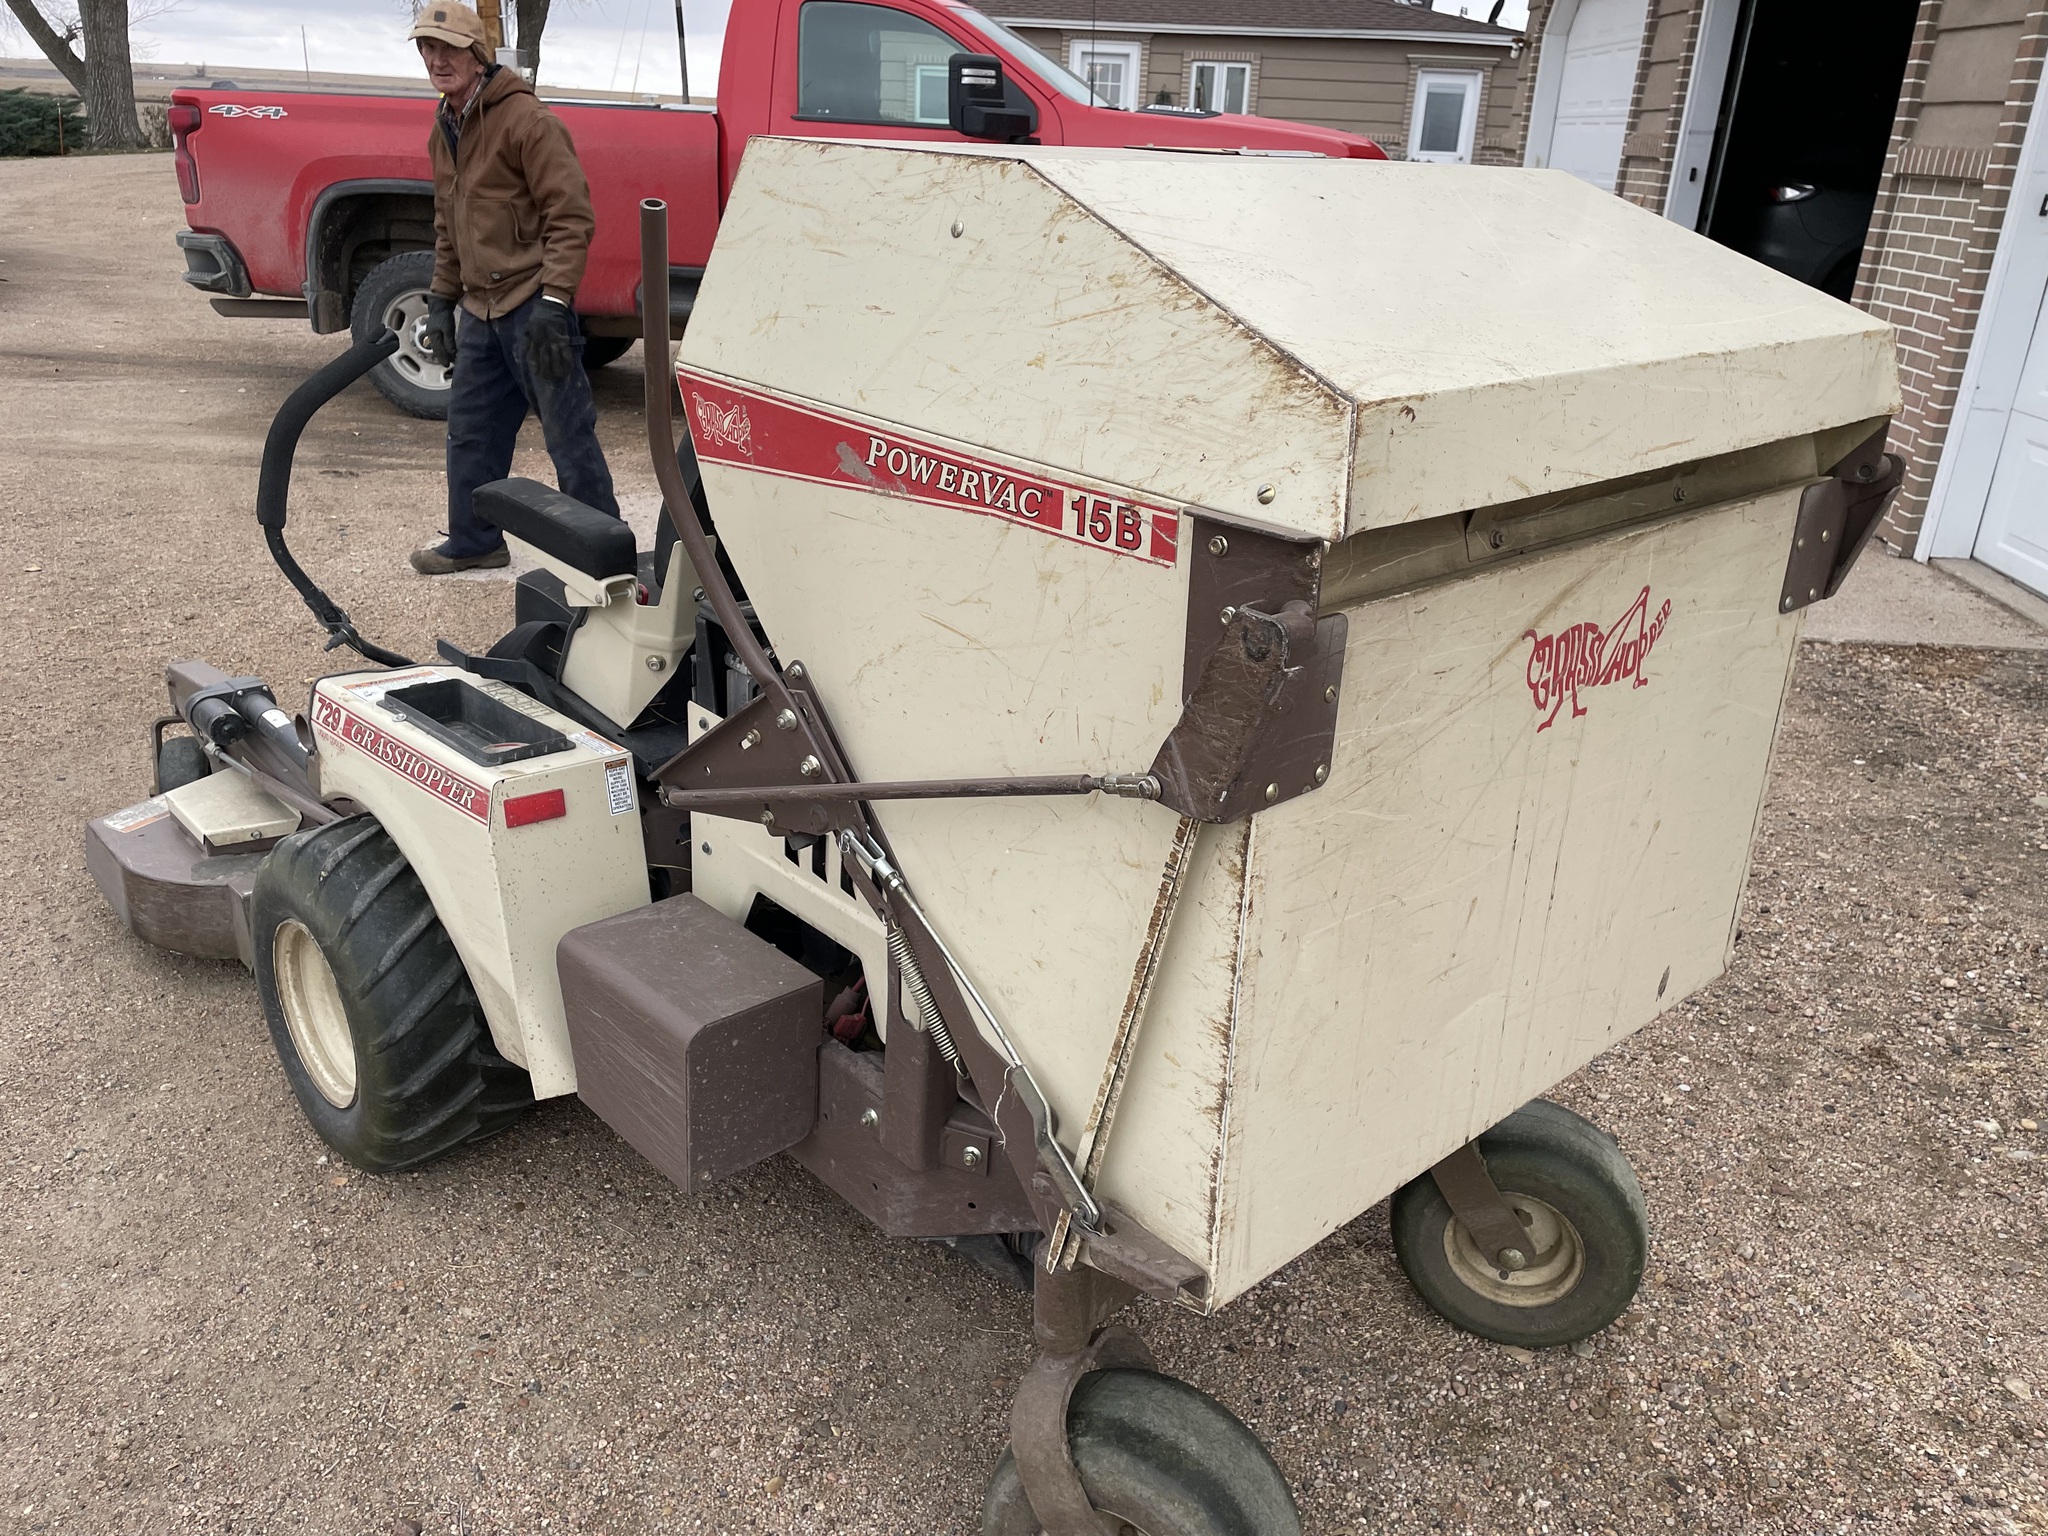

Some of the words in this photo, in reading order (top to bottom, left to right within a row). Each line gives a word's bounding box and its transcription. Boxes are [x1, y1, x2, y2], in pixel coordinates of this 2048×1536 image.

[865, 437, 1043, 518] POWERVAC
[1071, 496, 1142, 550] 15B
[316, 696, 341, 731] 729
[351, 723, 476, 810] GRASSHOPPER
